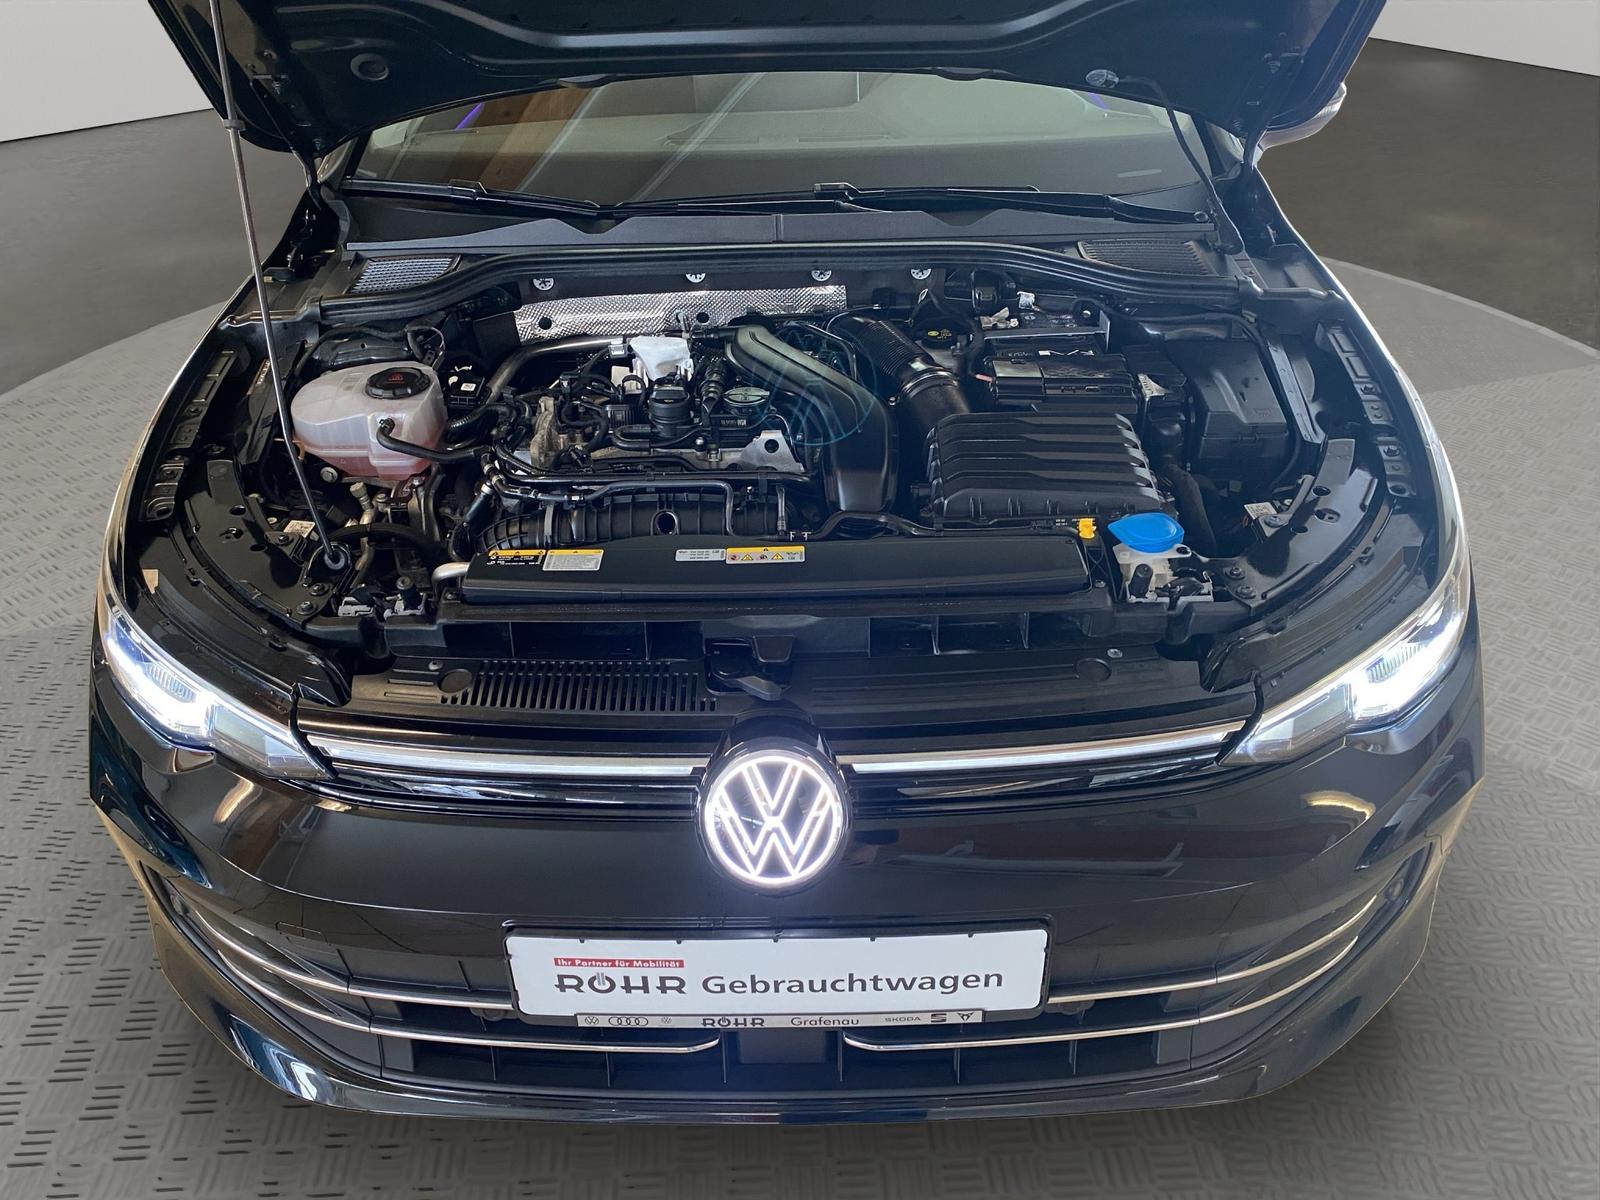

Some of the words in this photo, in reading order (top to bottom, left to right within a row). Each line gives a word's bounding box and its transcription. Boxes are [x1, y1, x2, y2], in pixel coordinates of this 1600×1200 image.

[557, 958, 572, 967] Ihr
[575, 959, 612, 967] Partner
[615, 959, 630, 968] für
[632, 960, 680, 968] Mobilität
[554, 972, 688, 994] RÖHR
[701, 972, 1003, 995] Gebrauchtwagen
[700, 1016, 766, 1027] RÖHR
[790, 1016, 860, 1026] Grafenau
